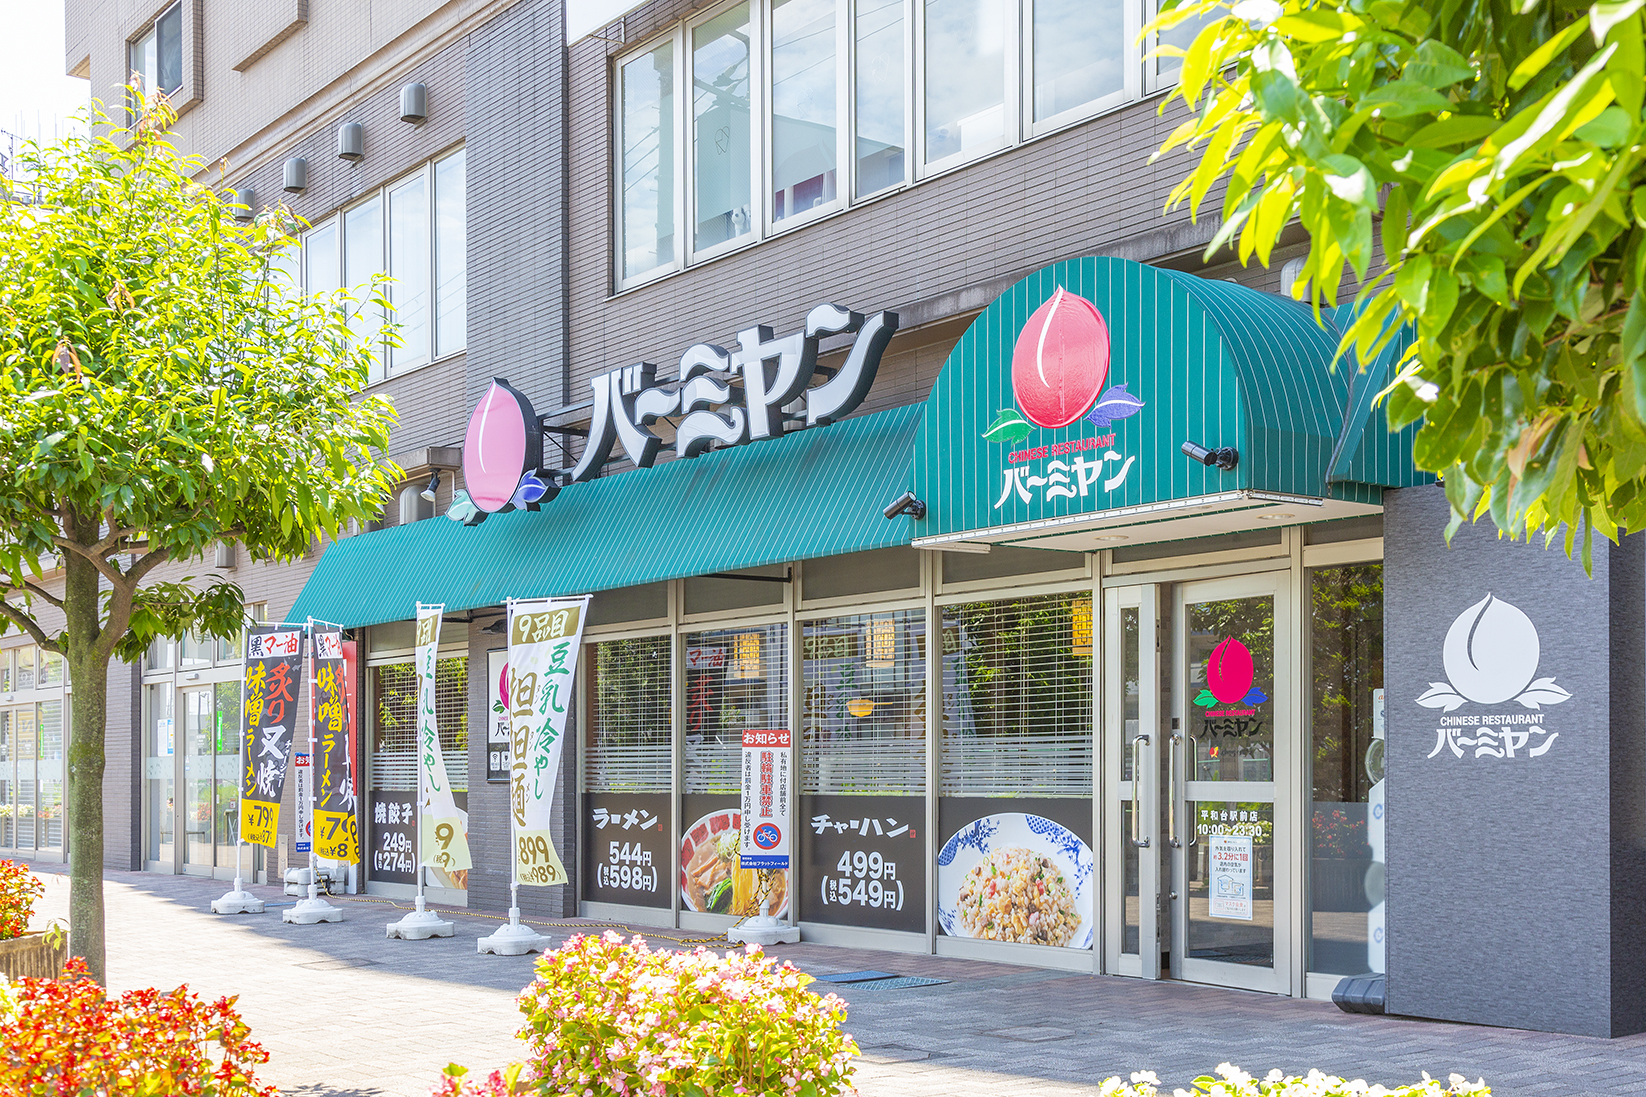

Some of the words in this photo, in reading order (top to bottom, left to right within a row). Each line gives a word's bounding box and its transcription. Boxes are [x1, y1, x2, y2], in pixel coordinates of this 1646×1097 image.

[571, 303, 898, 482] バーミヤン
[1008, 445, 1049, 464] CHINESE
[1051, 433, 1117, 457] RESTAURANT
[994, 450, 1136, 510] バーミヤン
[519, 610, 569, 643] 9品目
[248, 632, 299, 657] 黒マー油
[244, 660, 267, 798] 味噌ラーメン
[317, 661, 344, 808] 味噌ラーメン
[534, 641, 571, 800] 豆乳冷やし
[1200, 717, 1263, 738] バーミヤン
[1440, 716, 1480, 727] CHINESE
[1482, 714, 1545, 725] RESTAURANT
[743, 733, 790, 745] お知らせ
[1427, 725, 1559, 759] バーミヤン
[760, 751, 774, 818] 駐輪駐車禁止
[247, 804, 273, 829] ¥799
[374, 801, 413, 825] 焼餃子
[592, 808, 658, 831] ラーメン
[810, 814, 909, 838] チャーハン
[1201, 810, 1258, 821] 平和台駅前店
[383, 831, 412, 853] 249円
[1197, 823, 1263, 837] 10:00~23:30
[609, 841, 652, 867] 544円
[837, 850, 896, 880] 499円
[597, 862, 658, 893] (税込598円)
[821, 875, 905, 912] (税込549円)
